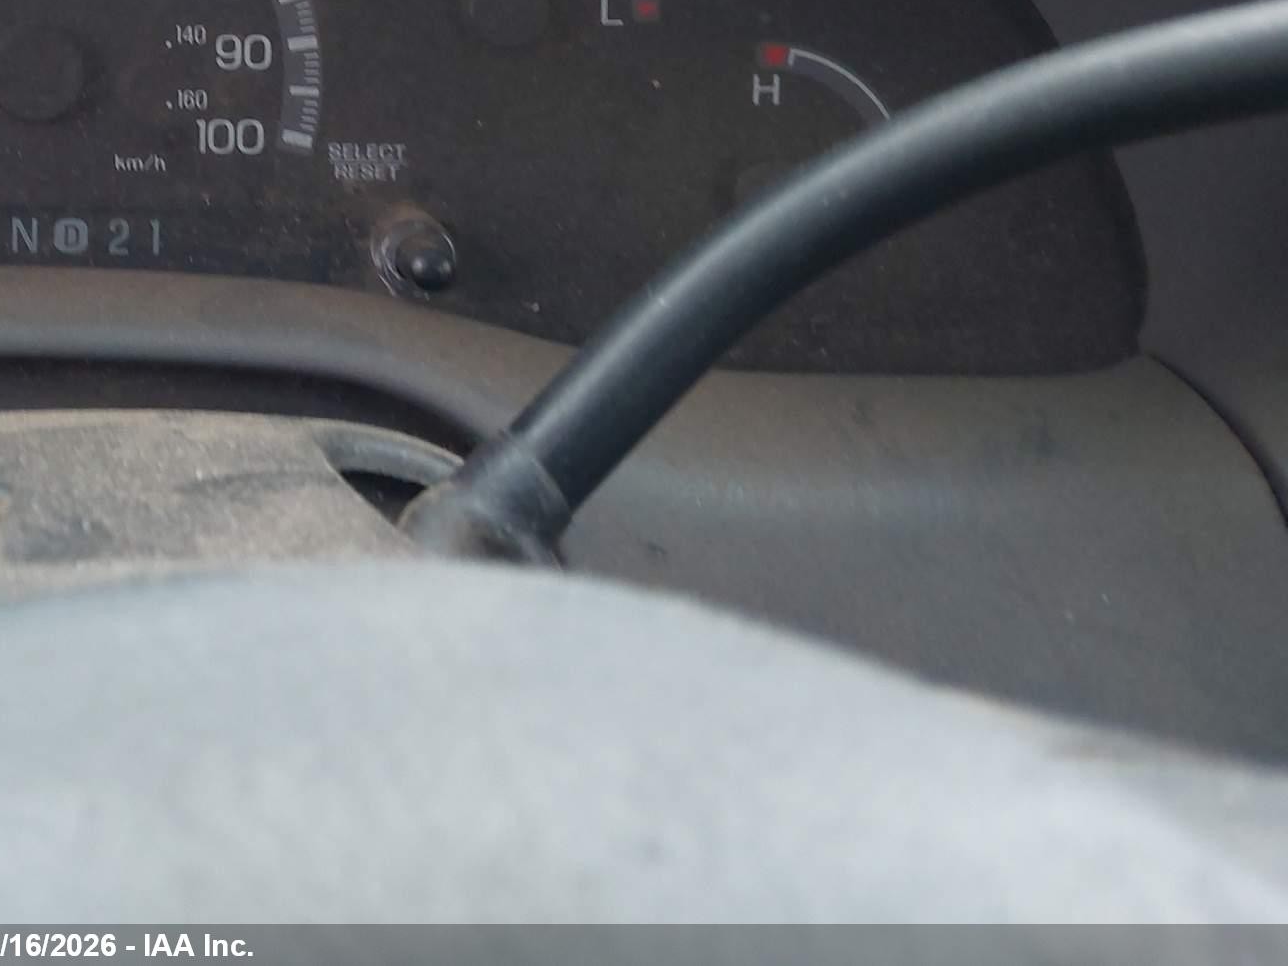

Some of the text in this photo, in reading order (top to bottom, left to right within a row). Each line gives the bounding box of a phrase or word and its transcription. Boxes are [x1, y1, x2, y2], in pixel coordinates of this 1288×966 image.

[176, 25, 206, 45] 140
[215, 34, 272, 70] 90
[177, 89, 207, 109] 160
[753, 74, 780, 105] H
[197, 119, 265, 155] 100
[328, 142, 407, 161] SELECT
[114, 153, 166, 172] km/h
[334, 163, 396, 182] RESET
[12, 218, 38, 253] N
[108, 218, 130, 255] 2
[149, 218, 161, 255] 1
